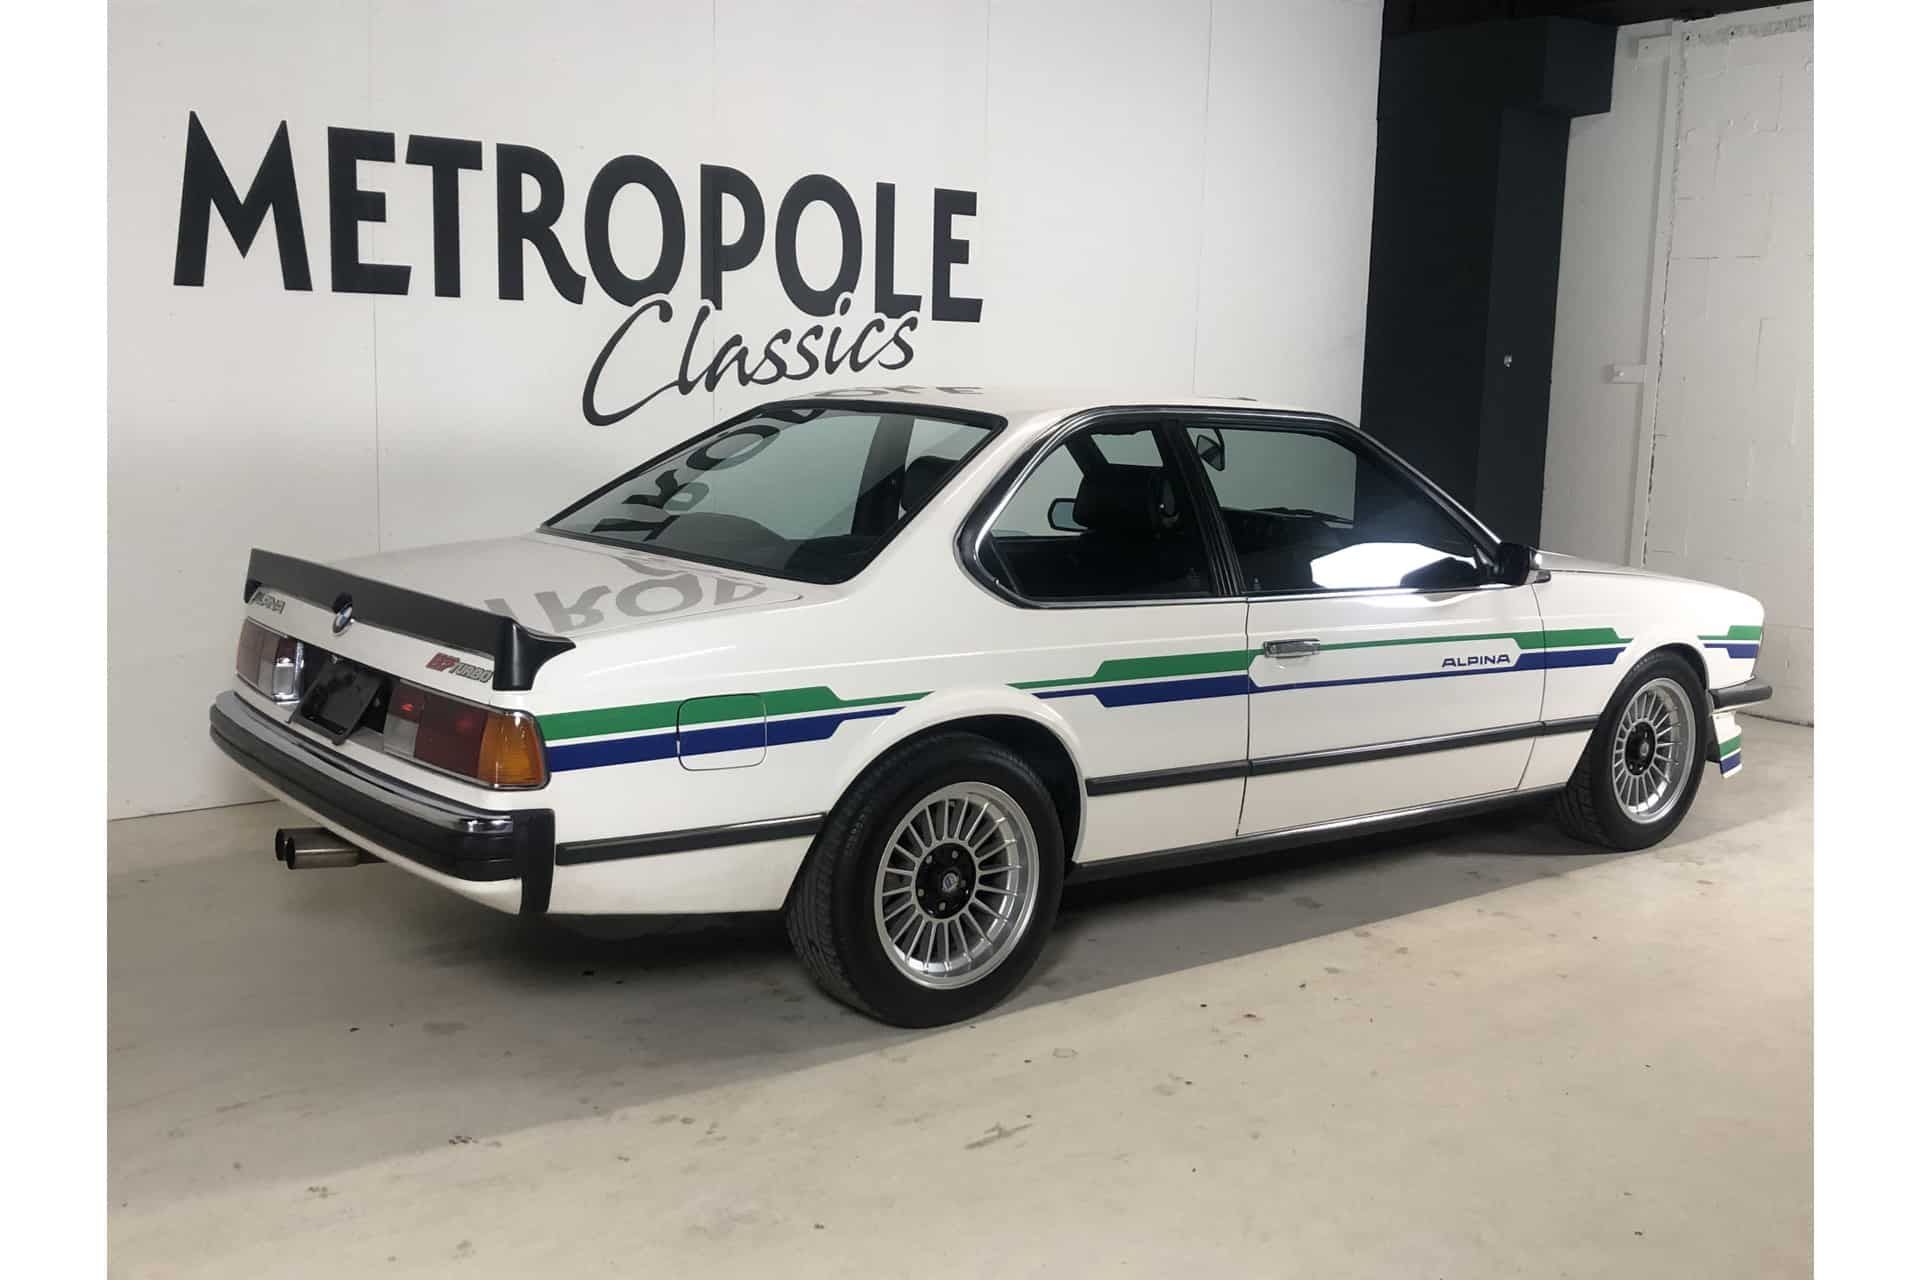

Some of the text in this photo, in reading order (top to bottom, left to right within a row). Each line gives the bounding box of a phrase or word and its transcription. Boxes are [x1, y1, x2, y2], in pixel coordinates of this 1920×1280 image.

[173, 110, 983, 323] METROPOLE
[582, 297, 918, 427] Classics
[1441, 654, 1511, 668] ALPINA
